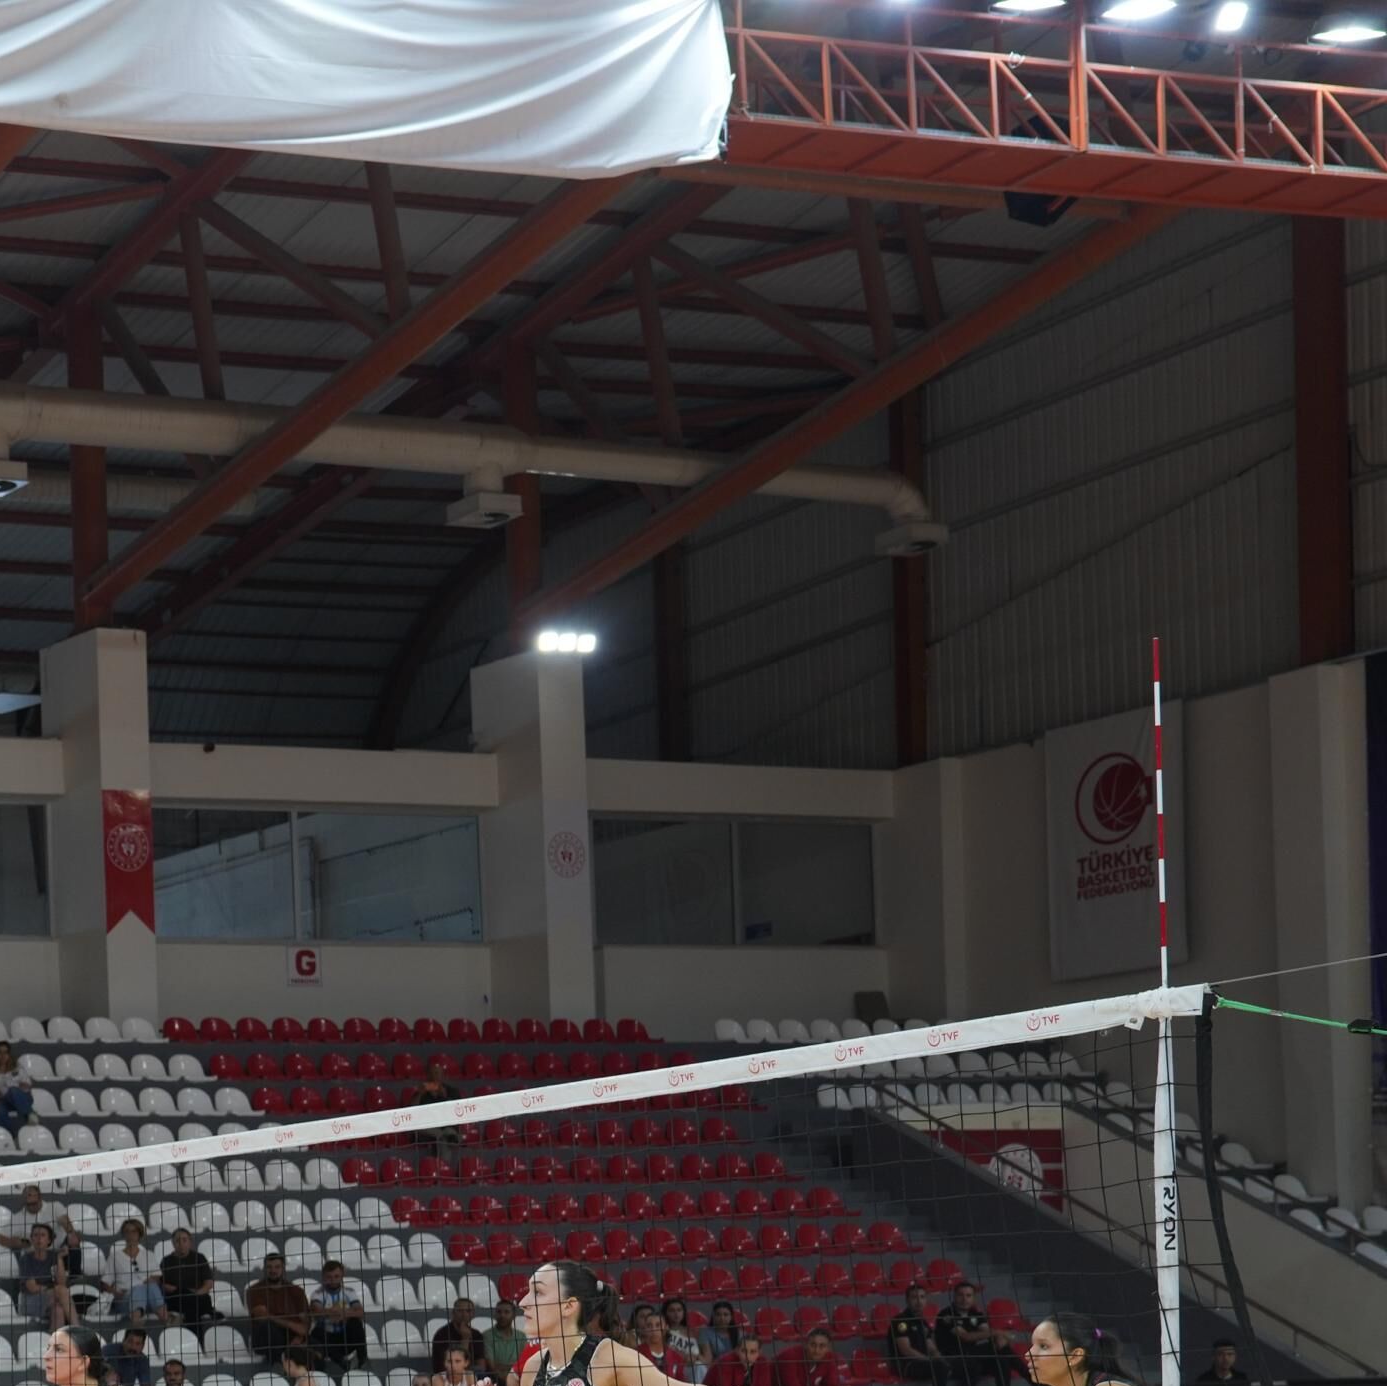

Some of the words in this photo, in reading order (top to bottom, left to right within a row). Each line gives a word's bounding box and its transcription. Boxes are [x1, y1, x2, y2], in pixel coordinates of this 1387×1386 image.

[1077, 844, 1155, 875] TÜRKİYE
[296, 949, 316, 976] G
[1042, 1014, 1060, 1026] TVF
[941, 1031, 959, 1043] TVF
[847, 1046, 865, 1057] TVF
[761, 1060, 776, 1071] TVF
[679, 1073, 695, 1083] TVF
[603, 1085, 618, 1095] TVF
[1162, 1170, 1177, 1251] TRYON
